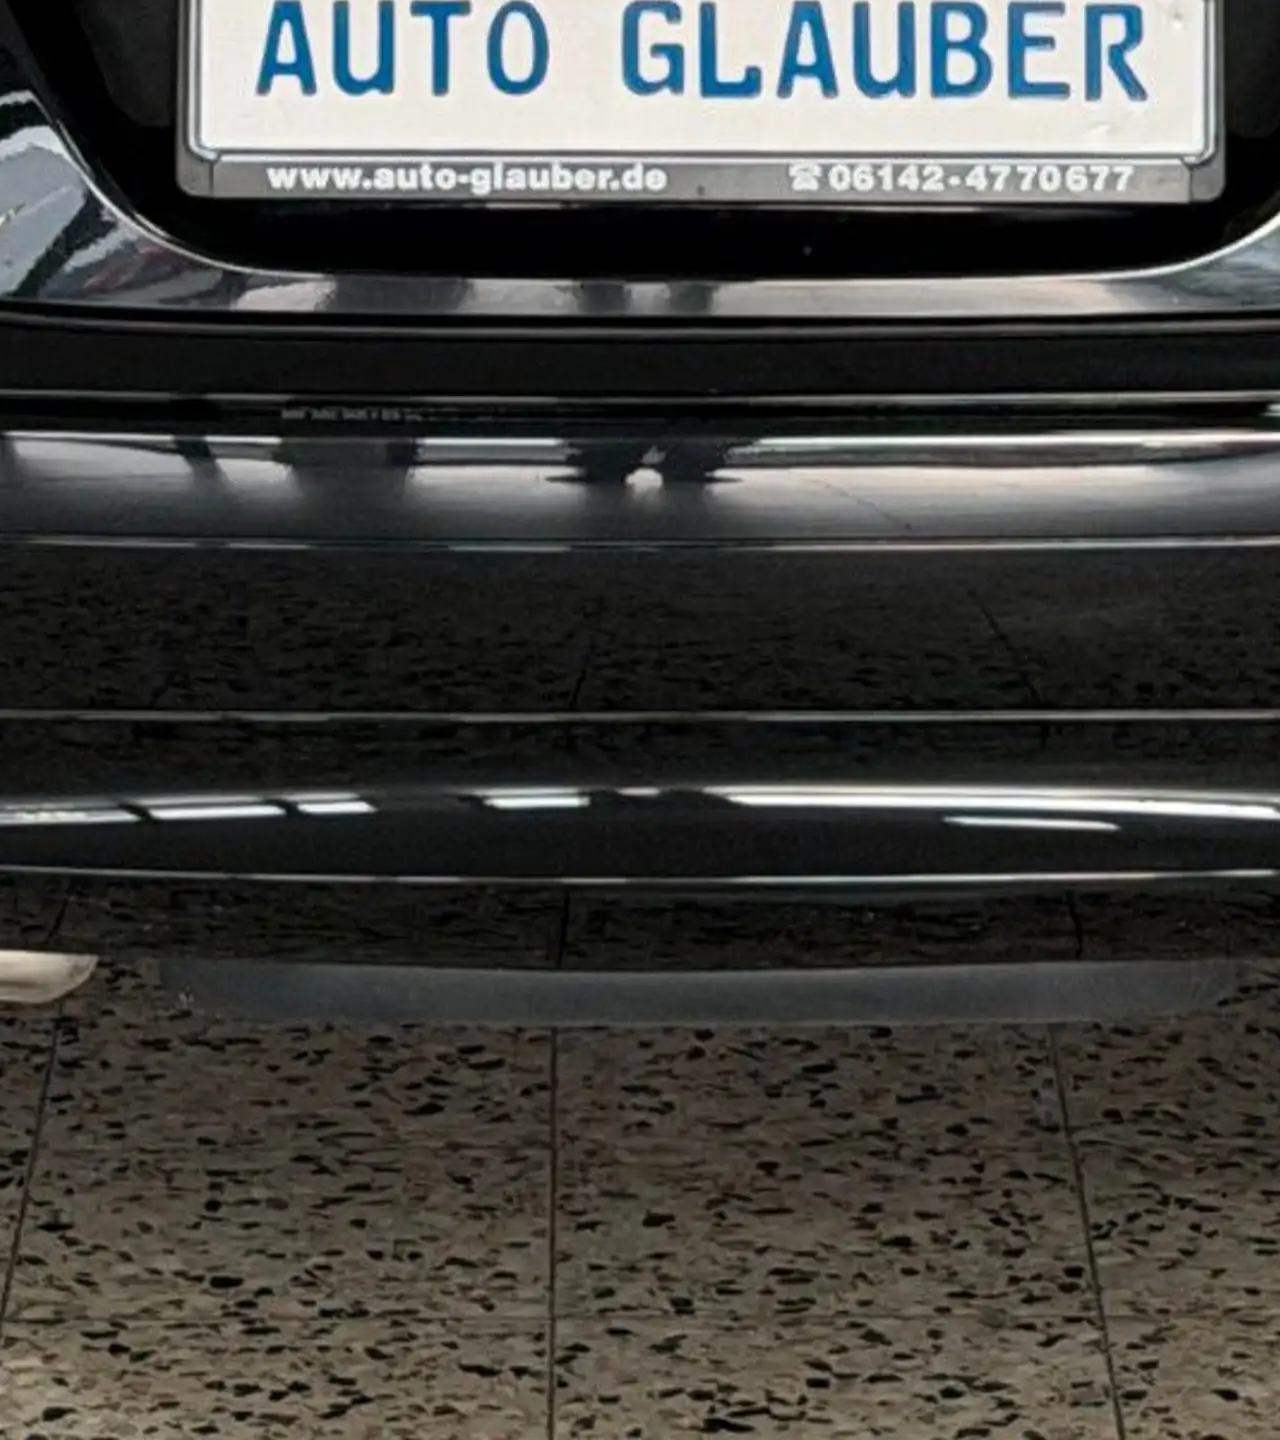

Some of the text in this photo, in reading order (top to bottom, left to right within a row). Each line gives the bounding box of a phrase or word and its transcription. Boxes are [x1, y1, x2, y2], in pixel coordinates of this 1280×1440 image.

[258, 0, 1146, 101] AUTO GLAUBER
[266, 163, 1135, 195] www.auto-glauber.de 06142-4770677
